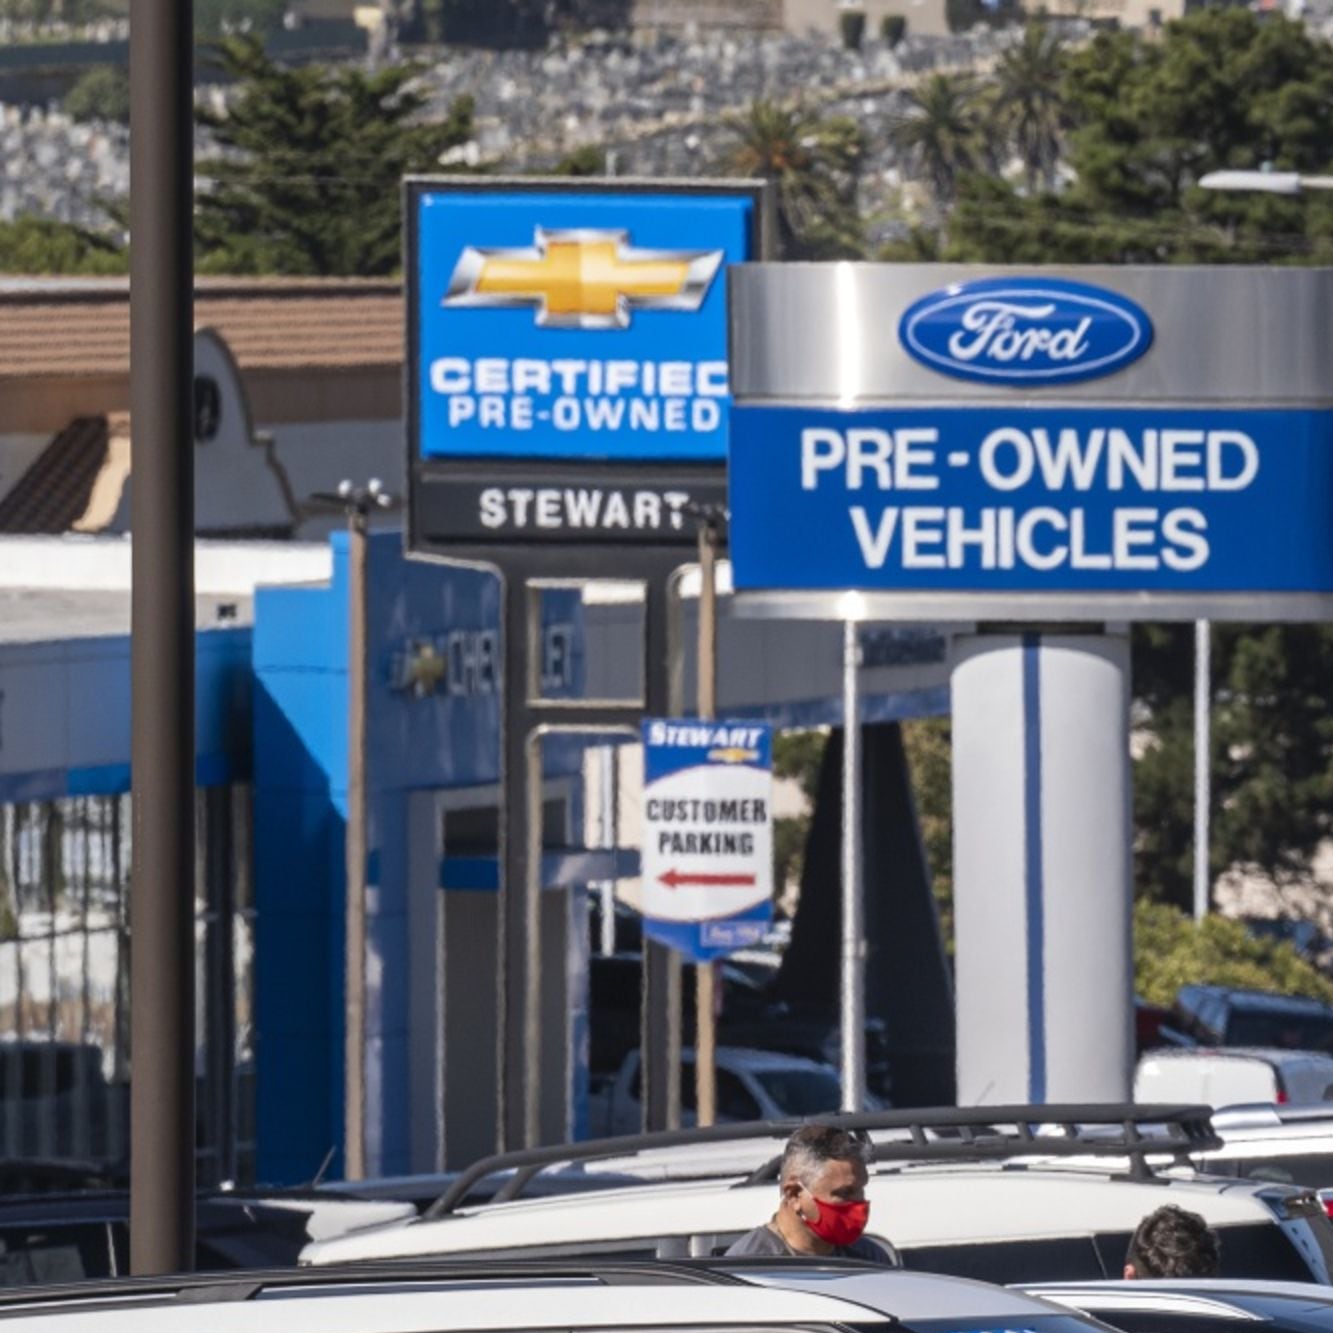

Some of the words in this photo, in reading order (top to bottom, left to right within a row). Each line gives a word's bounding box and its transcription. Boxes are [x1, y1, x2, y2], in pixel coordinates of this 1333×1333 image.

[949, 300, 1091, 363] Ford
[448, 396, 720, 431] PRE-OWNED
[479, 488, 688, 530] STEWART
[850, 506, 1209, 571] VEHICLES
[648, 721, 763, 747] STEWART
[646, 799, 767, 823] CUSTOMER
[658, 832, 754, 856] PARKING
